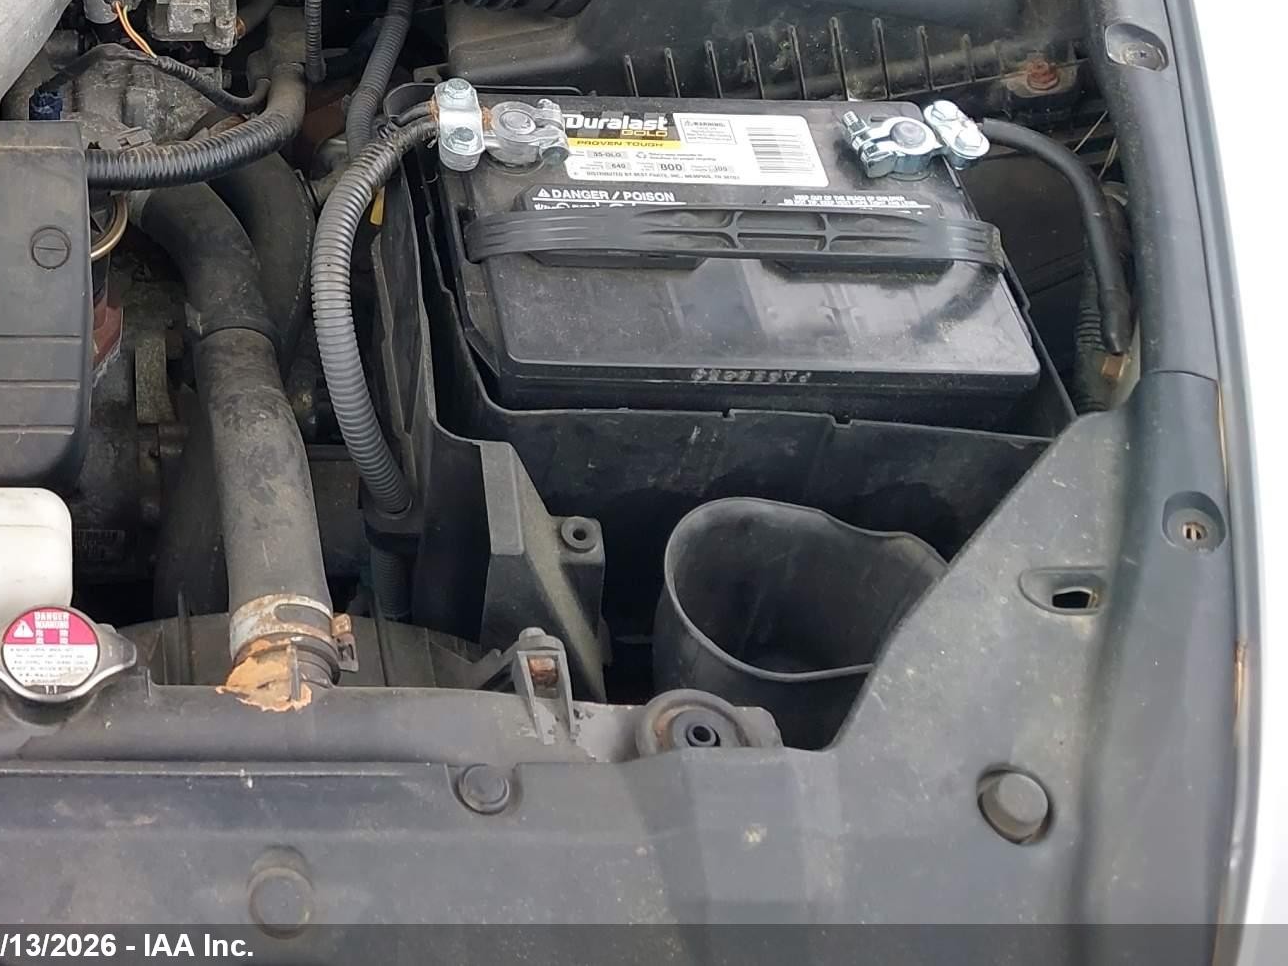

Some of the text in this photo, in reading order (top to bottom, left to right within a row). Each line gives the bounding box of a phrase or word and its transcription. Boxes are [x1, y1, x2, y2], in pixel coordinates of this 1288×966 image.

[562, 113, 668, 131] Duralast
[621, 129, 668, 137] GOLD
[551, 188, 609, 200] DANGER
[622, 191, 675, 202] POISON
